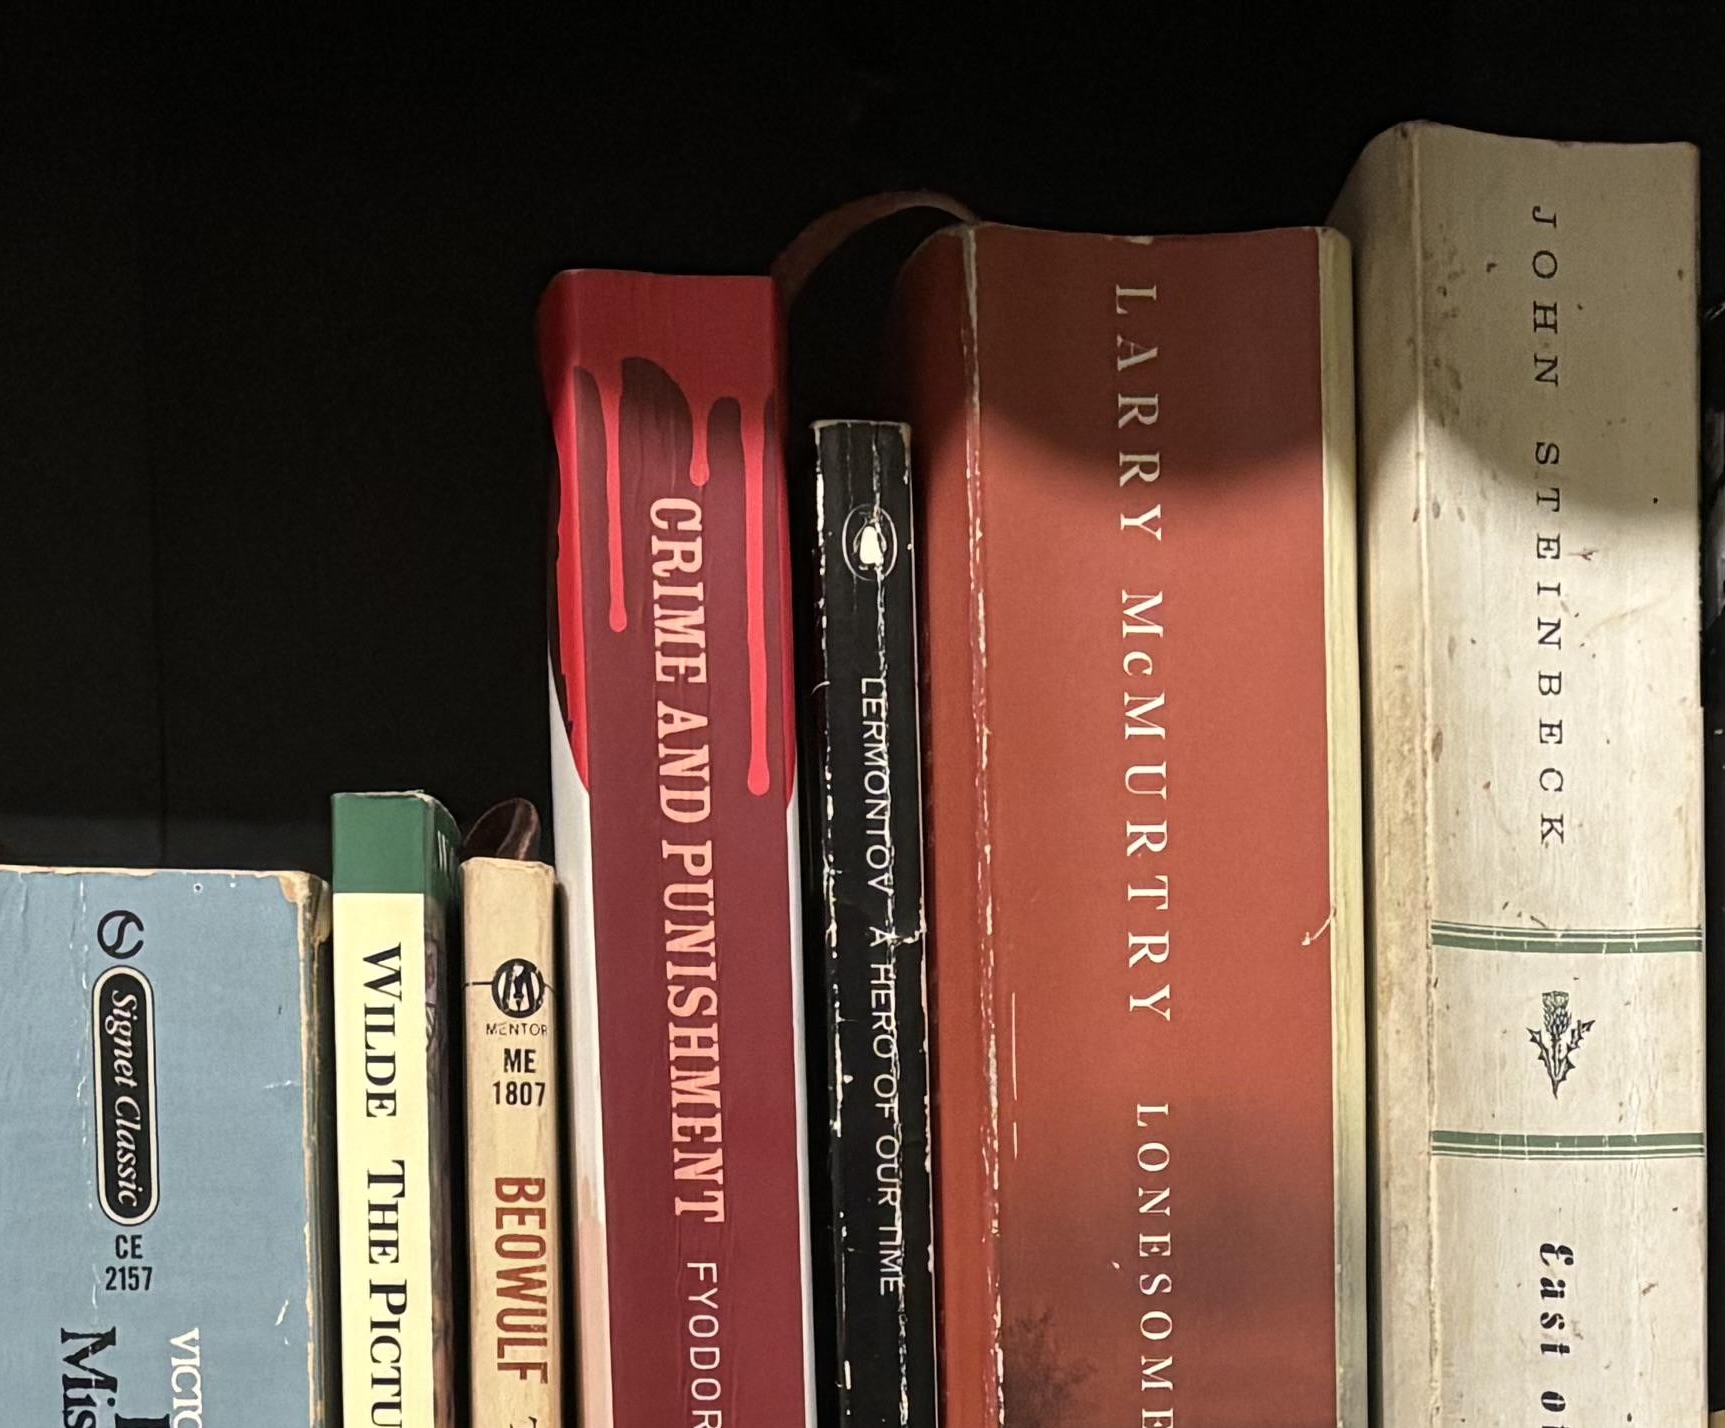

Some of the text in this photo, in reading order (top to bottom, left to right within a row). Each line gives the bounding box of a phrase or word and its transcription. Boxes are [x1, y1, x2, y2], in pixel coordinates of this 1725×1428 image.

[1115, 284, 1162, 542] LARRY
[649, 497, 707, 684] CRIME
[657, 700, 711, 824] AND
[1121, 589, 1171, 1021] McMURTRY
[362, 942, 403, 1119] WILDE
[492, 1080, 546, 1108] 1807
[503, 1047, 537, 1074] ME
[661, 839, 725, 1223] PUNISHMENT
[105, 1265, 153, 1292] 2157
[114, 1234, 144, 1260] CE
[366, 1159, 406, 1265] THE
[494, 1177, 549, 1385] BEOWULF
